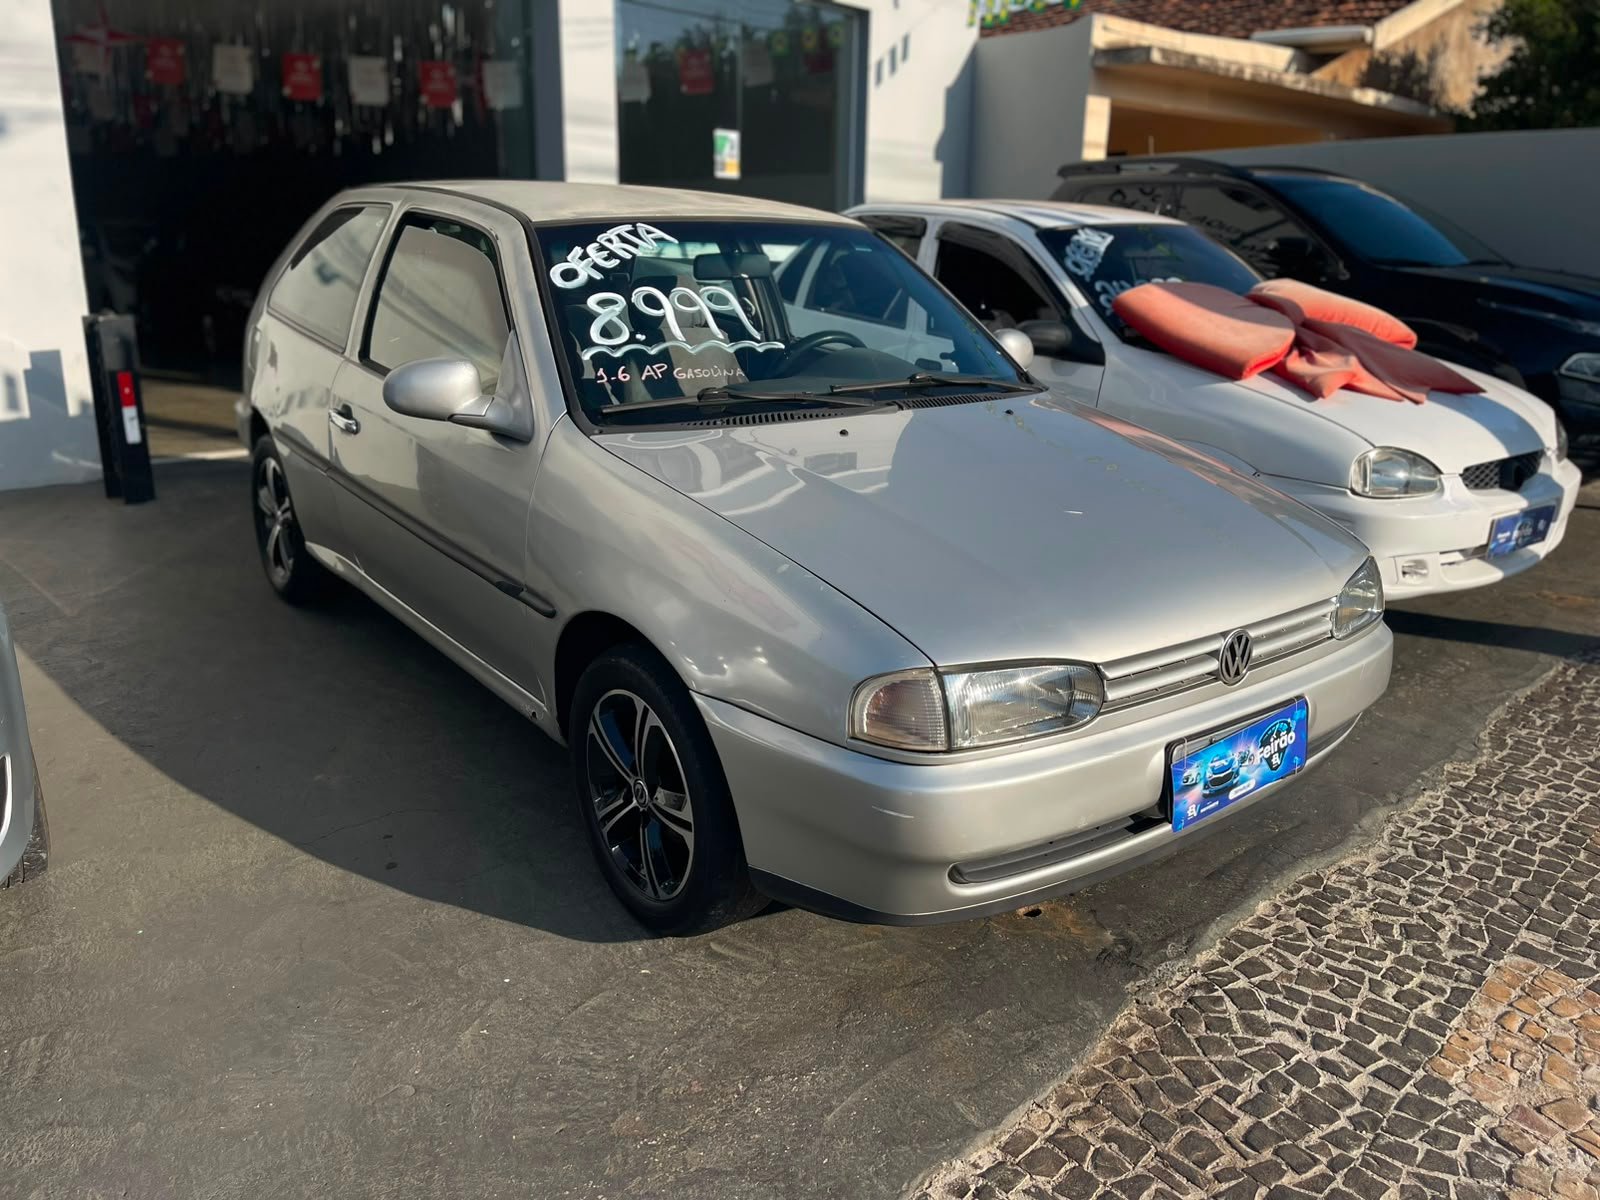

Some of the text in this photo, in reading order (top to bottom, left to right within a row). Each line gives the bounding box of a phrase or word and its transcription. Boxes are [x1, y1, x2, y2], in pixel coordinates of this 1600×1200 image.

[549, 223, 679, 289] OFERTA
[587, 286, 762, 345] 8.999
[641, 363, 668, 380] AP
[673, 365, 746, 380] GASOLINA
[1256, 730, 1296, 763] Feirão
